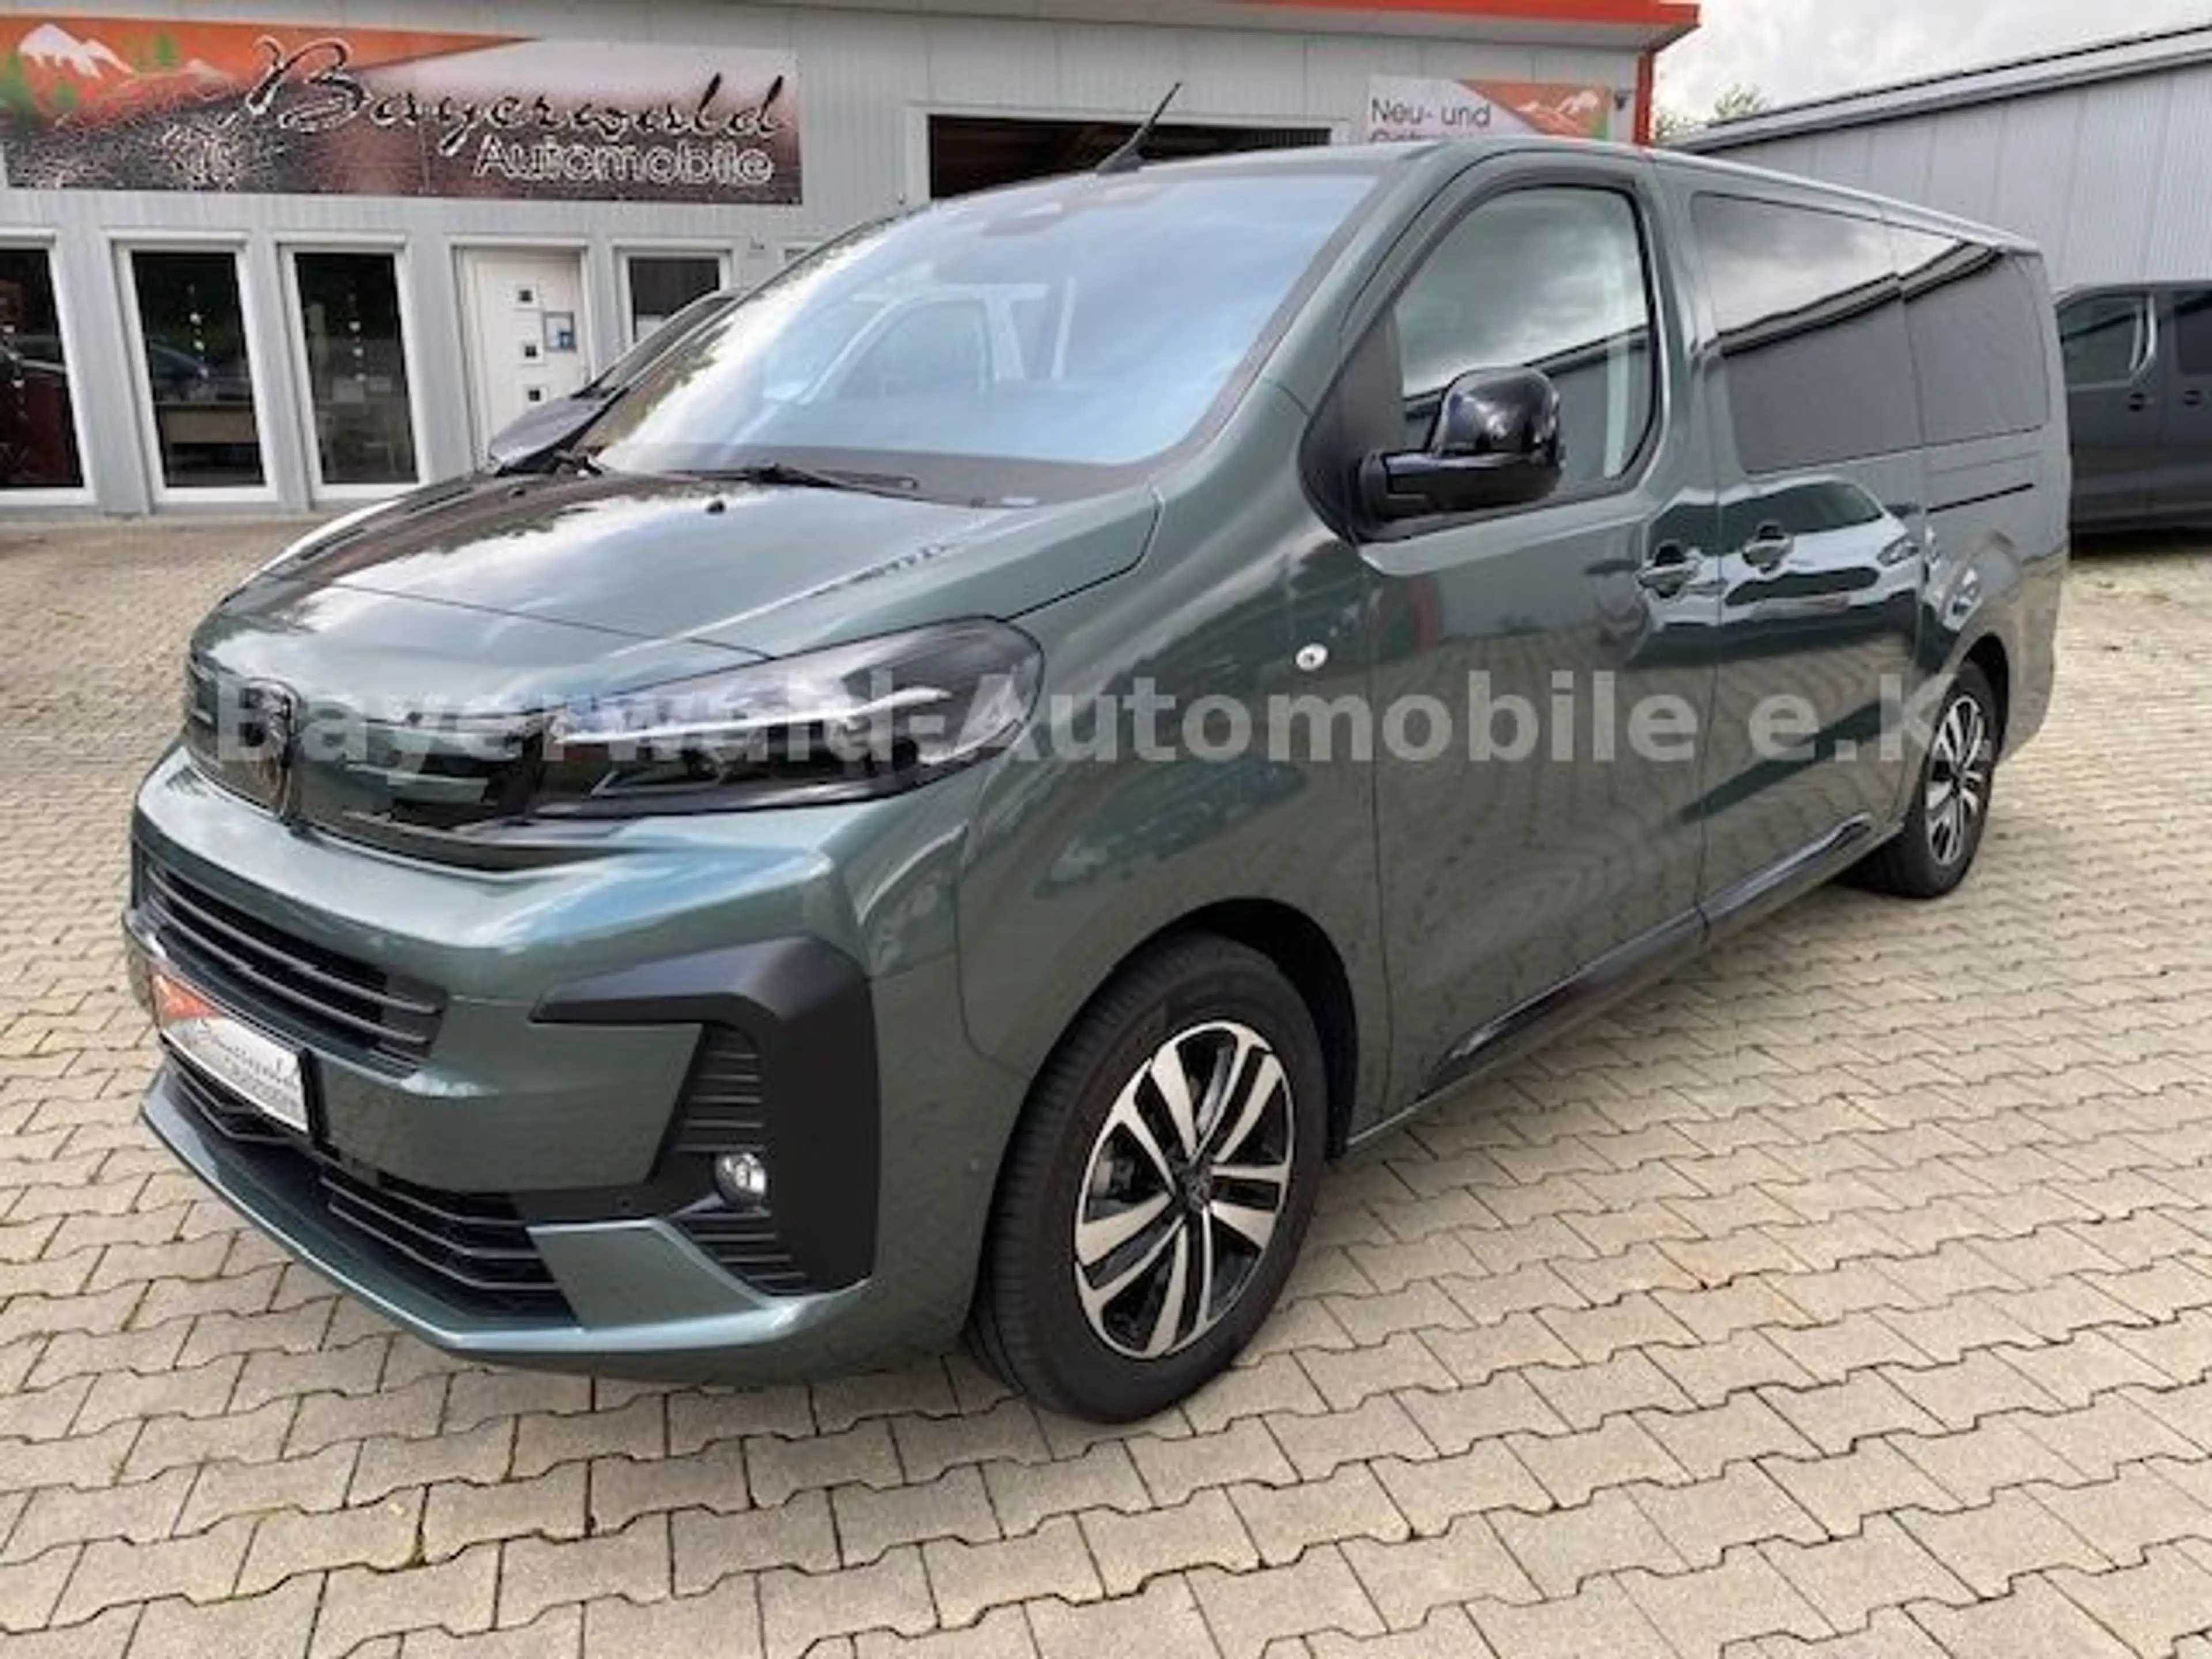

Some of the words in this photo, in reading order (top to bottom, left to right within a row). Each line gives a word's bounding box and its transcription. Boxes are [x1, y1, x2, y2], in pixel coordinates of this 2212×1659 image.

[219, 35, 785, 157] Bayerwald
[1372, 99, 1433, 125] Neu-
[1441, 103, 1491, 127] und
[474, 133, 775, 184] Automobile
